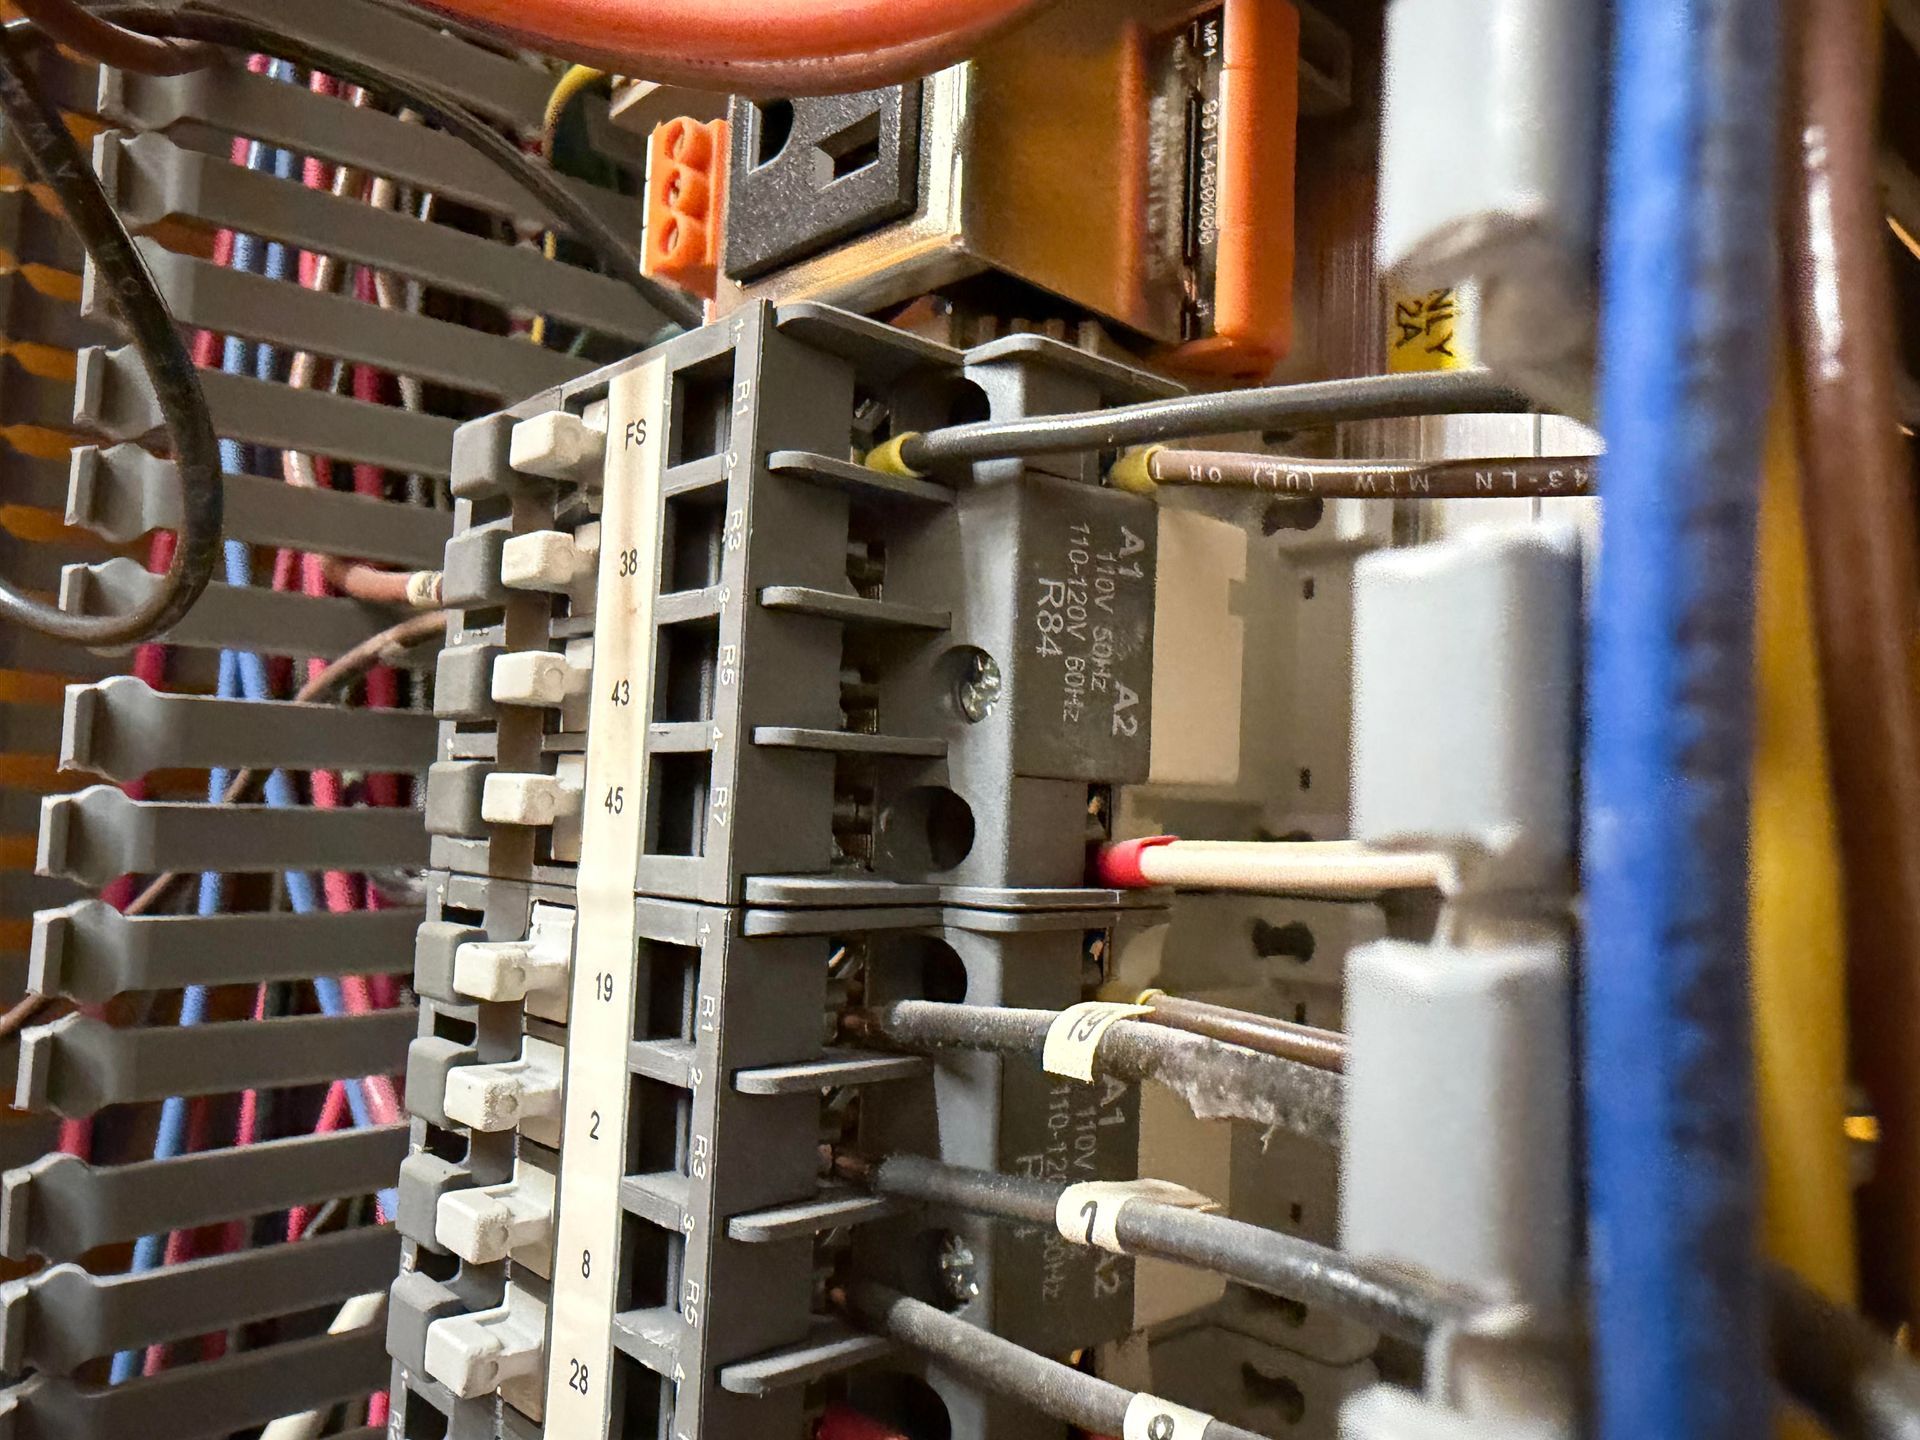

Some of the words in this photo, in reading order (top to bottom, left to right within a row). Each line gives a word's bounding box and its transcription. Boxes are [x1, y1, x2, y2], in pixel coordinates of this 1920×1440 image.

[737, 379, 751, 416] R1
[625, 418, 648, 450] FS
[728, 508, 744, 550] R3
[619, 548, 638, 577] 38
[1117, 525, 1146, 579] A1
[1066, 521, 1091, 642] 110-120V
[1094, 551, 1118, 614] 110V
[1035, 577, 1066, 658] R84
[721, 644, 737, 686] R5
[1090, 625, 1113, 694] 50Hz
[611, 679, 630, 707] 43
[1062, 655, 1086, 723] 60Hz
[1112, 680, 1140, 737] A2
[604, 786, 624, 815] 45
[713, 786, 728, 827] R7
[595, 971, 613, 1002] 19
[702, 994, 715, 1032] R1
[1098, 1073, 1127, 1127] A1
[589, 1110, 600, 1140] 2
[1073, 1105, 1098, 1170] 110V
[692, 1134, 708, 1181] R3
[581, 1249, 591, 1279] 8
[684, 1279, 700, 1328] R5
[568, 1358, 589, 1395] 28
